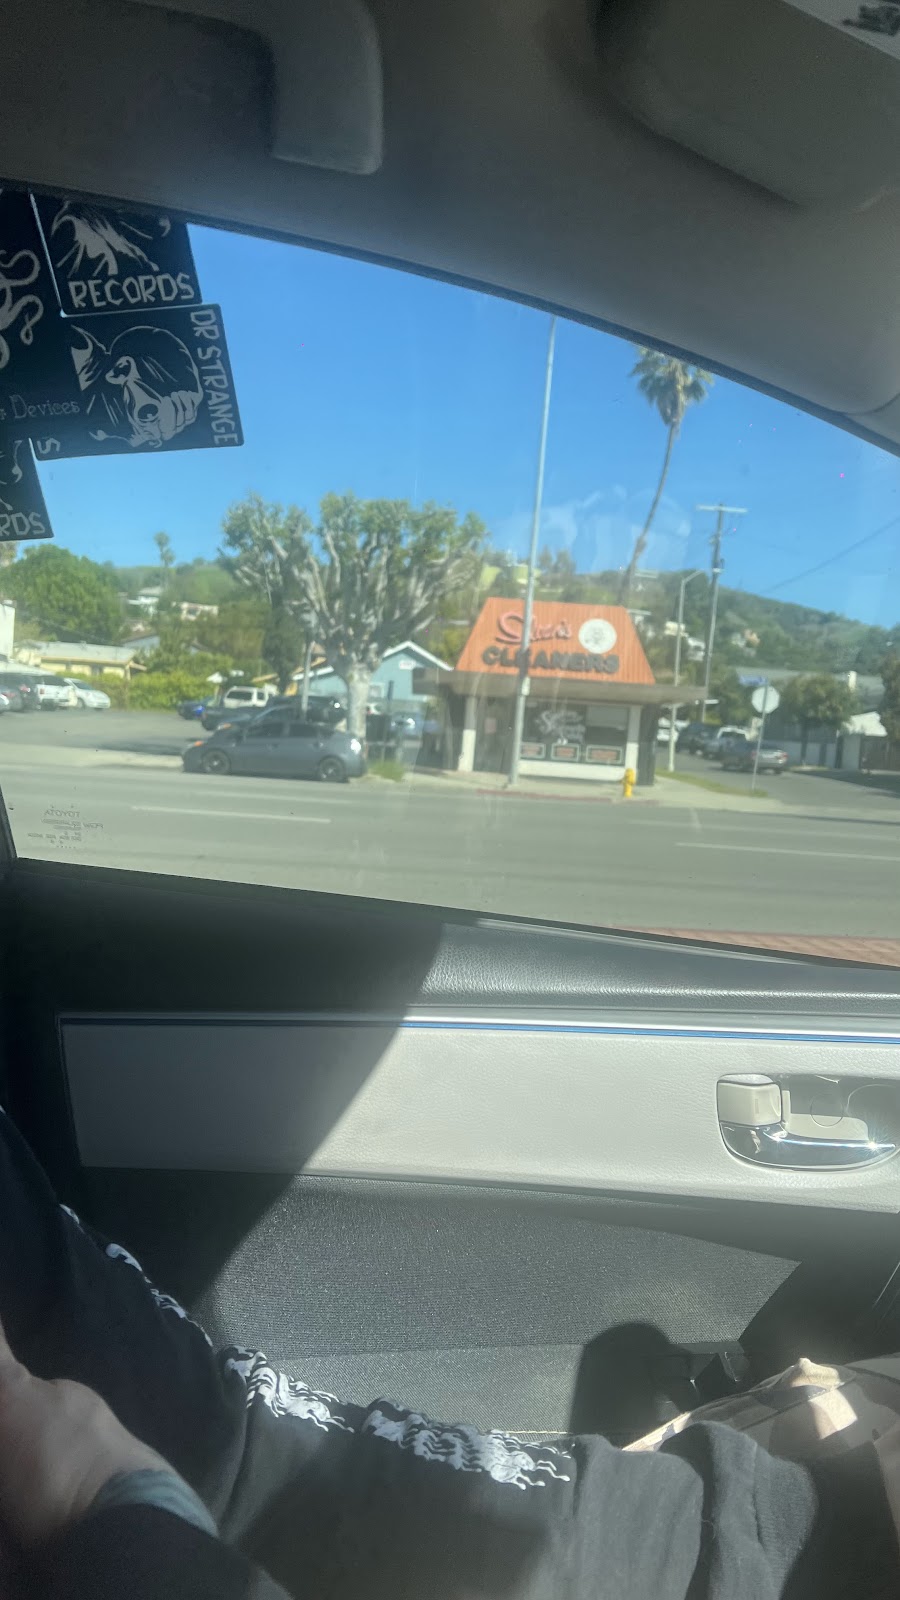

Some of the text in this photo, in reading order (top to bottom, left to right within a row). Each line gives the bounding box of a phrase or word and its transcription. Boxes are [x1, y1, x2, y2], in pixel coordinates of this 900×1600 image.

[68, 272, 195, 308] RECORDS
[190, 309, 239, 445] DR STRANGE
[9, 394, 80, 419] Devices
